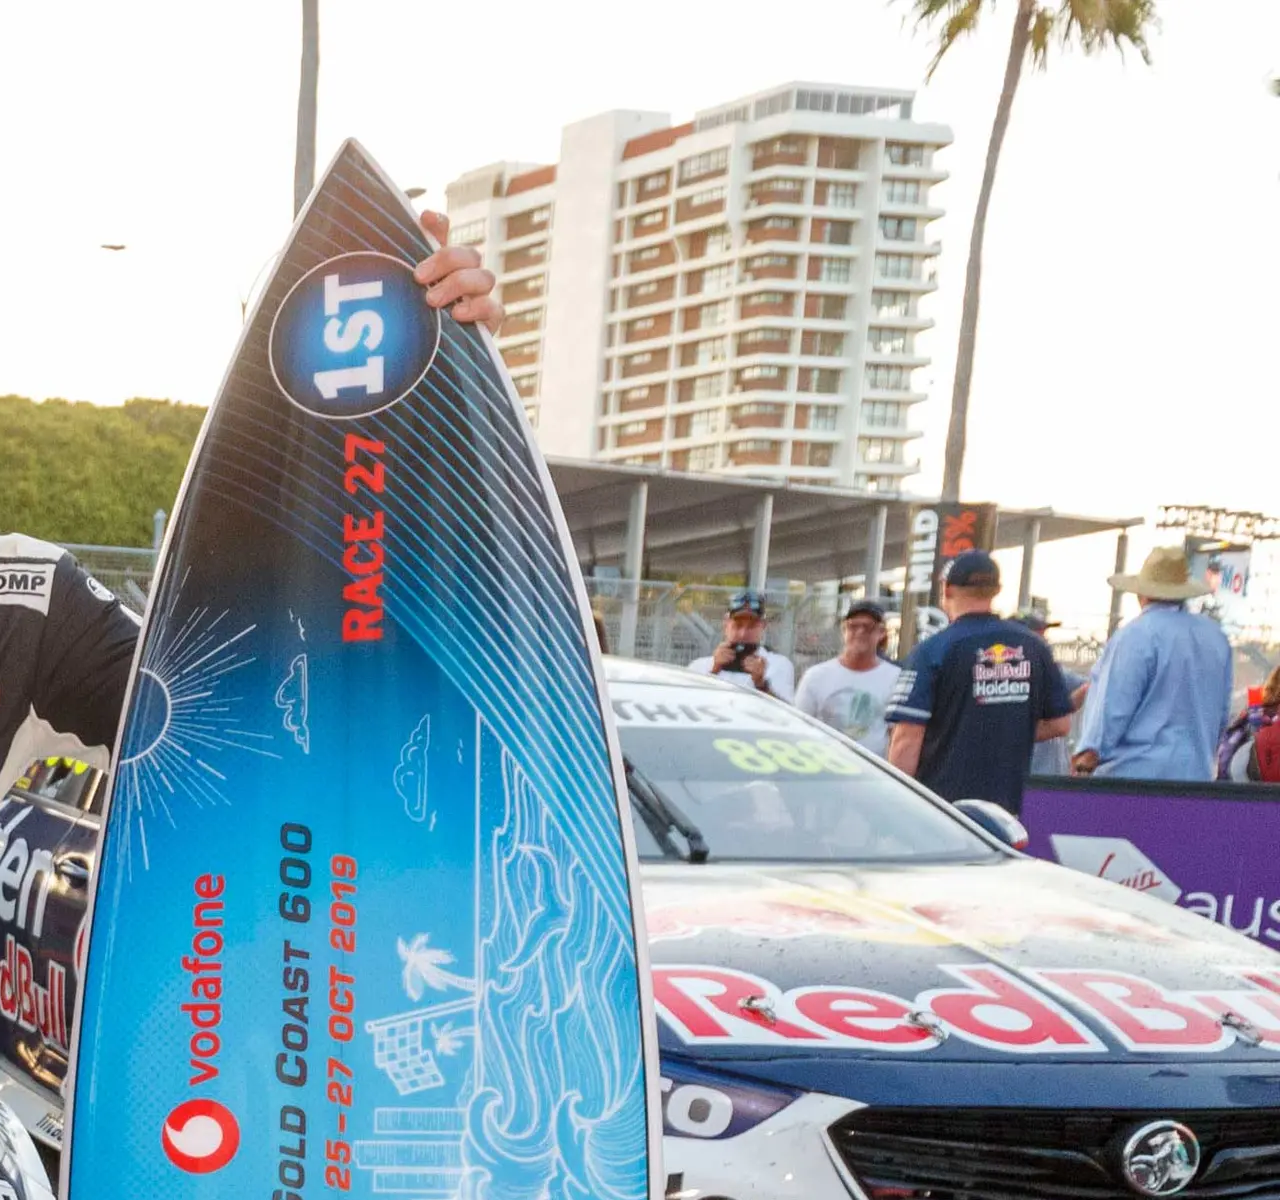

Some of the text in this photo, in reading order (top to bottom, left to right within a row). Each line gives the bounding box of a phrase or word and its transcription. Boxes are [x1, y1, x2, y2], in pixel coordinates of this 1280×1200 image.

[313, 273, 385, 400] 1ST
[343, 432, 386, 644] RACE 27
[973, 680, 1031, 697] Holden
[712, 738, 862, 775] 888
[279, 822, 313, 925] 600
[329, 853, 358, 954] 2019
[180, 872, 226, 1087] vodafone
[275, 939, 310, 1088] COAST
[327, 964, 356, 1043] OCT
